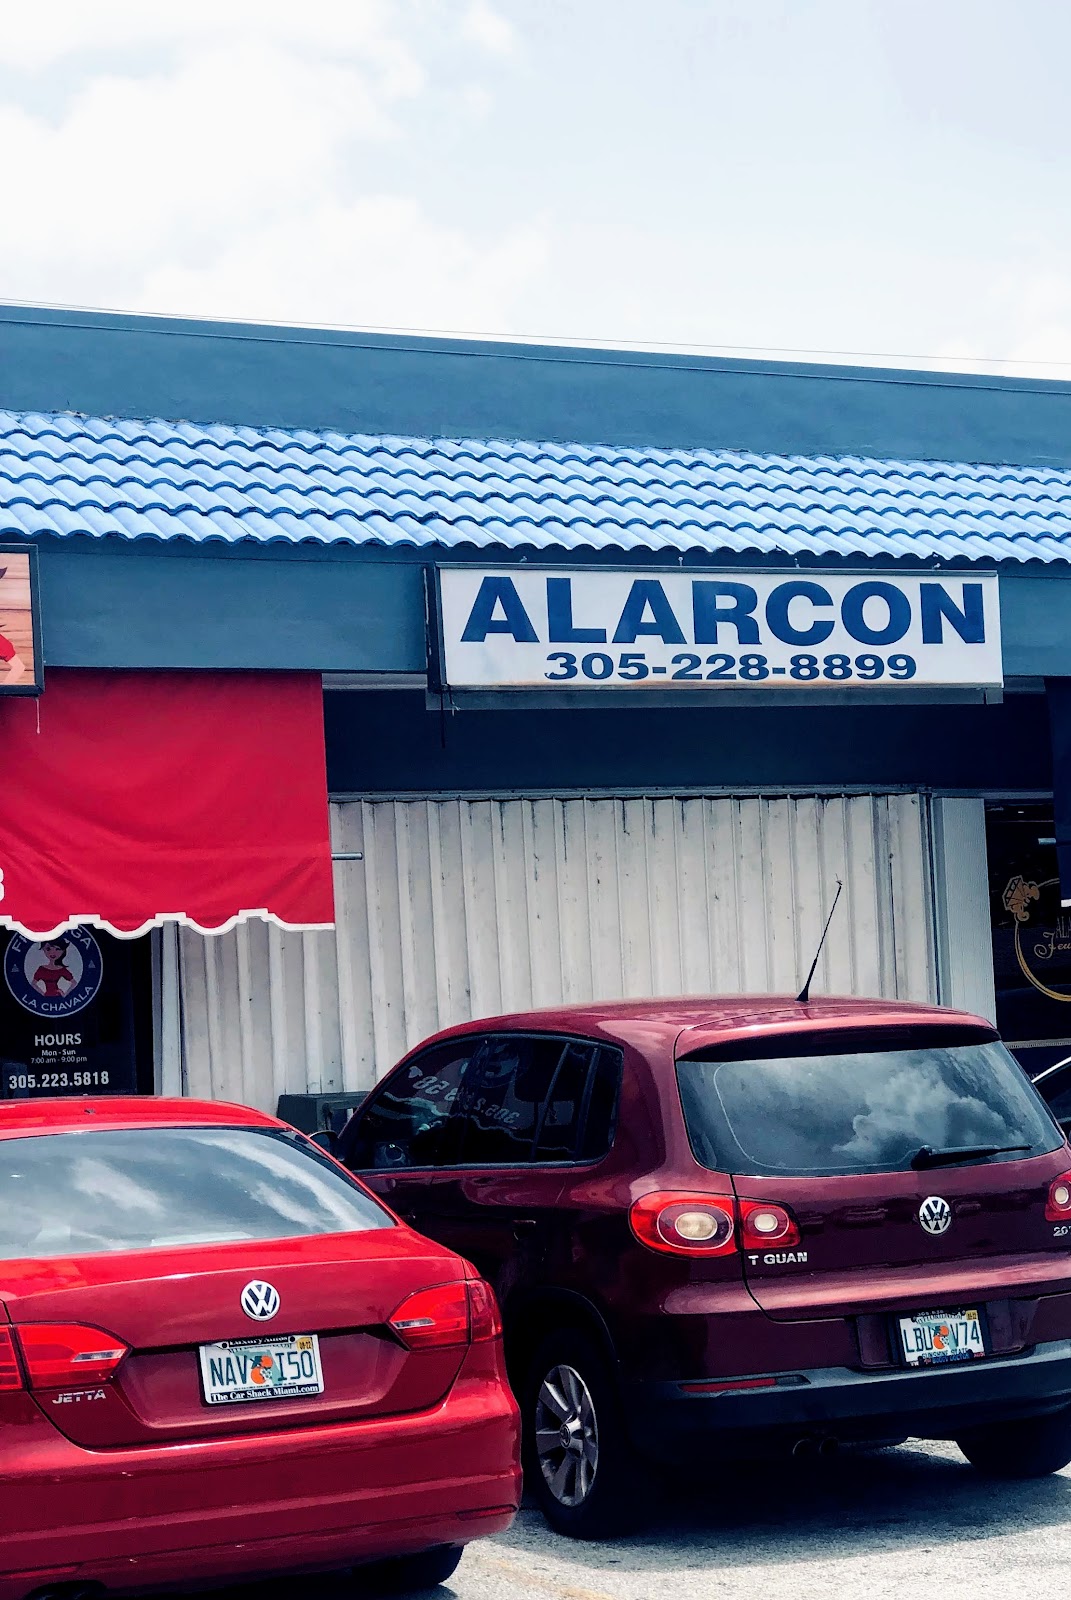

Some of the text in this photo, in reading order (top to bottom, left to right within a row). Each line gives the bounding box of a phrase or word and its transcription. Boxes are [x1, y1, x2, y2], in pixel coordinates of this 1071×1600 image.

[460, 576, 986, 646] ALARCON
[545, 651, 917, 681] 305-228-8899
[21, 986, 94, 1012] LA CHAVALA
[34, 1033, 82, 1047] HOURS
[62, 1048, 76, 1056] Sun
[9, 1071, 110, 1089] 305.223.5818
[903, 1320, 980, 1353] LBU V74
[209, 1355, 248, 1387] NAV
[52, 1389, 106, 1404] JETTA
[211, 1393, 228, 1401] The
[230, 1391, 245, 1399] Car
[246, 1389, 272, 1398] Shack
[273, 1385, 319, 1397] Miami.com
